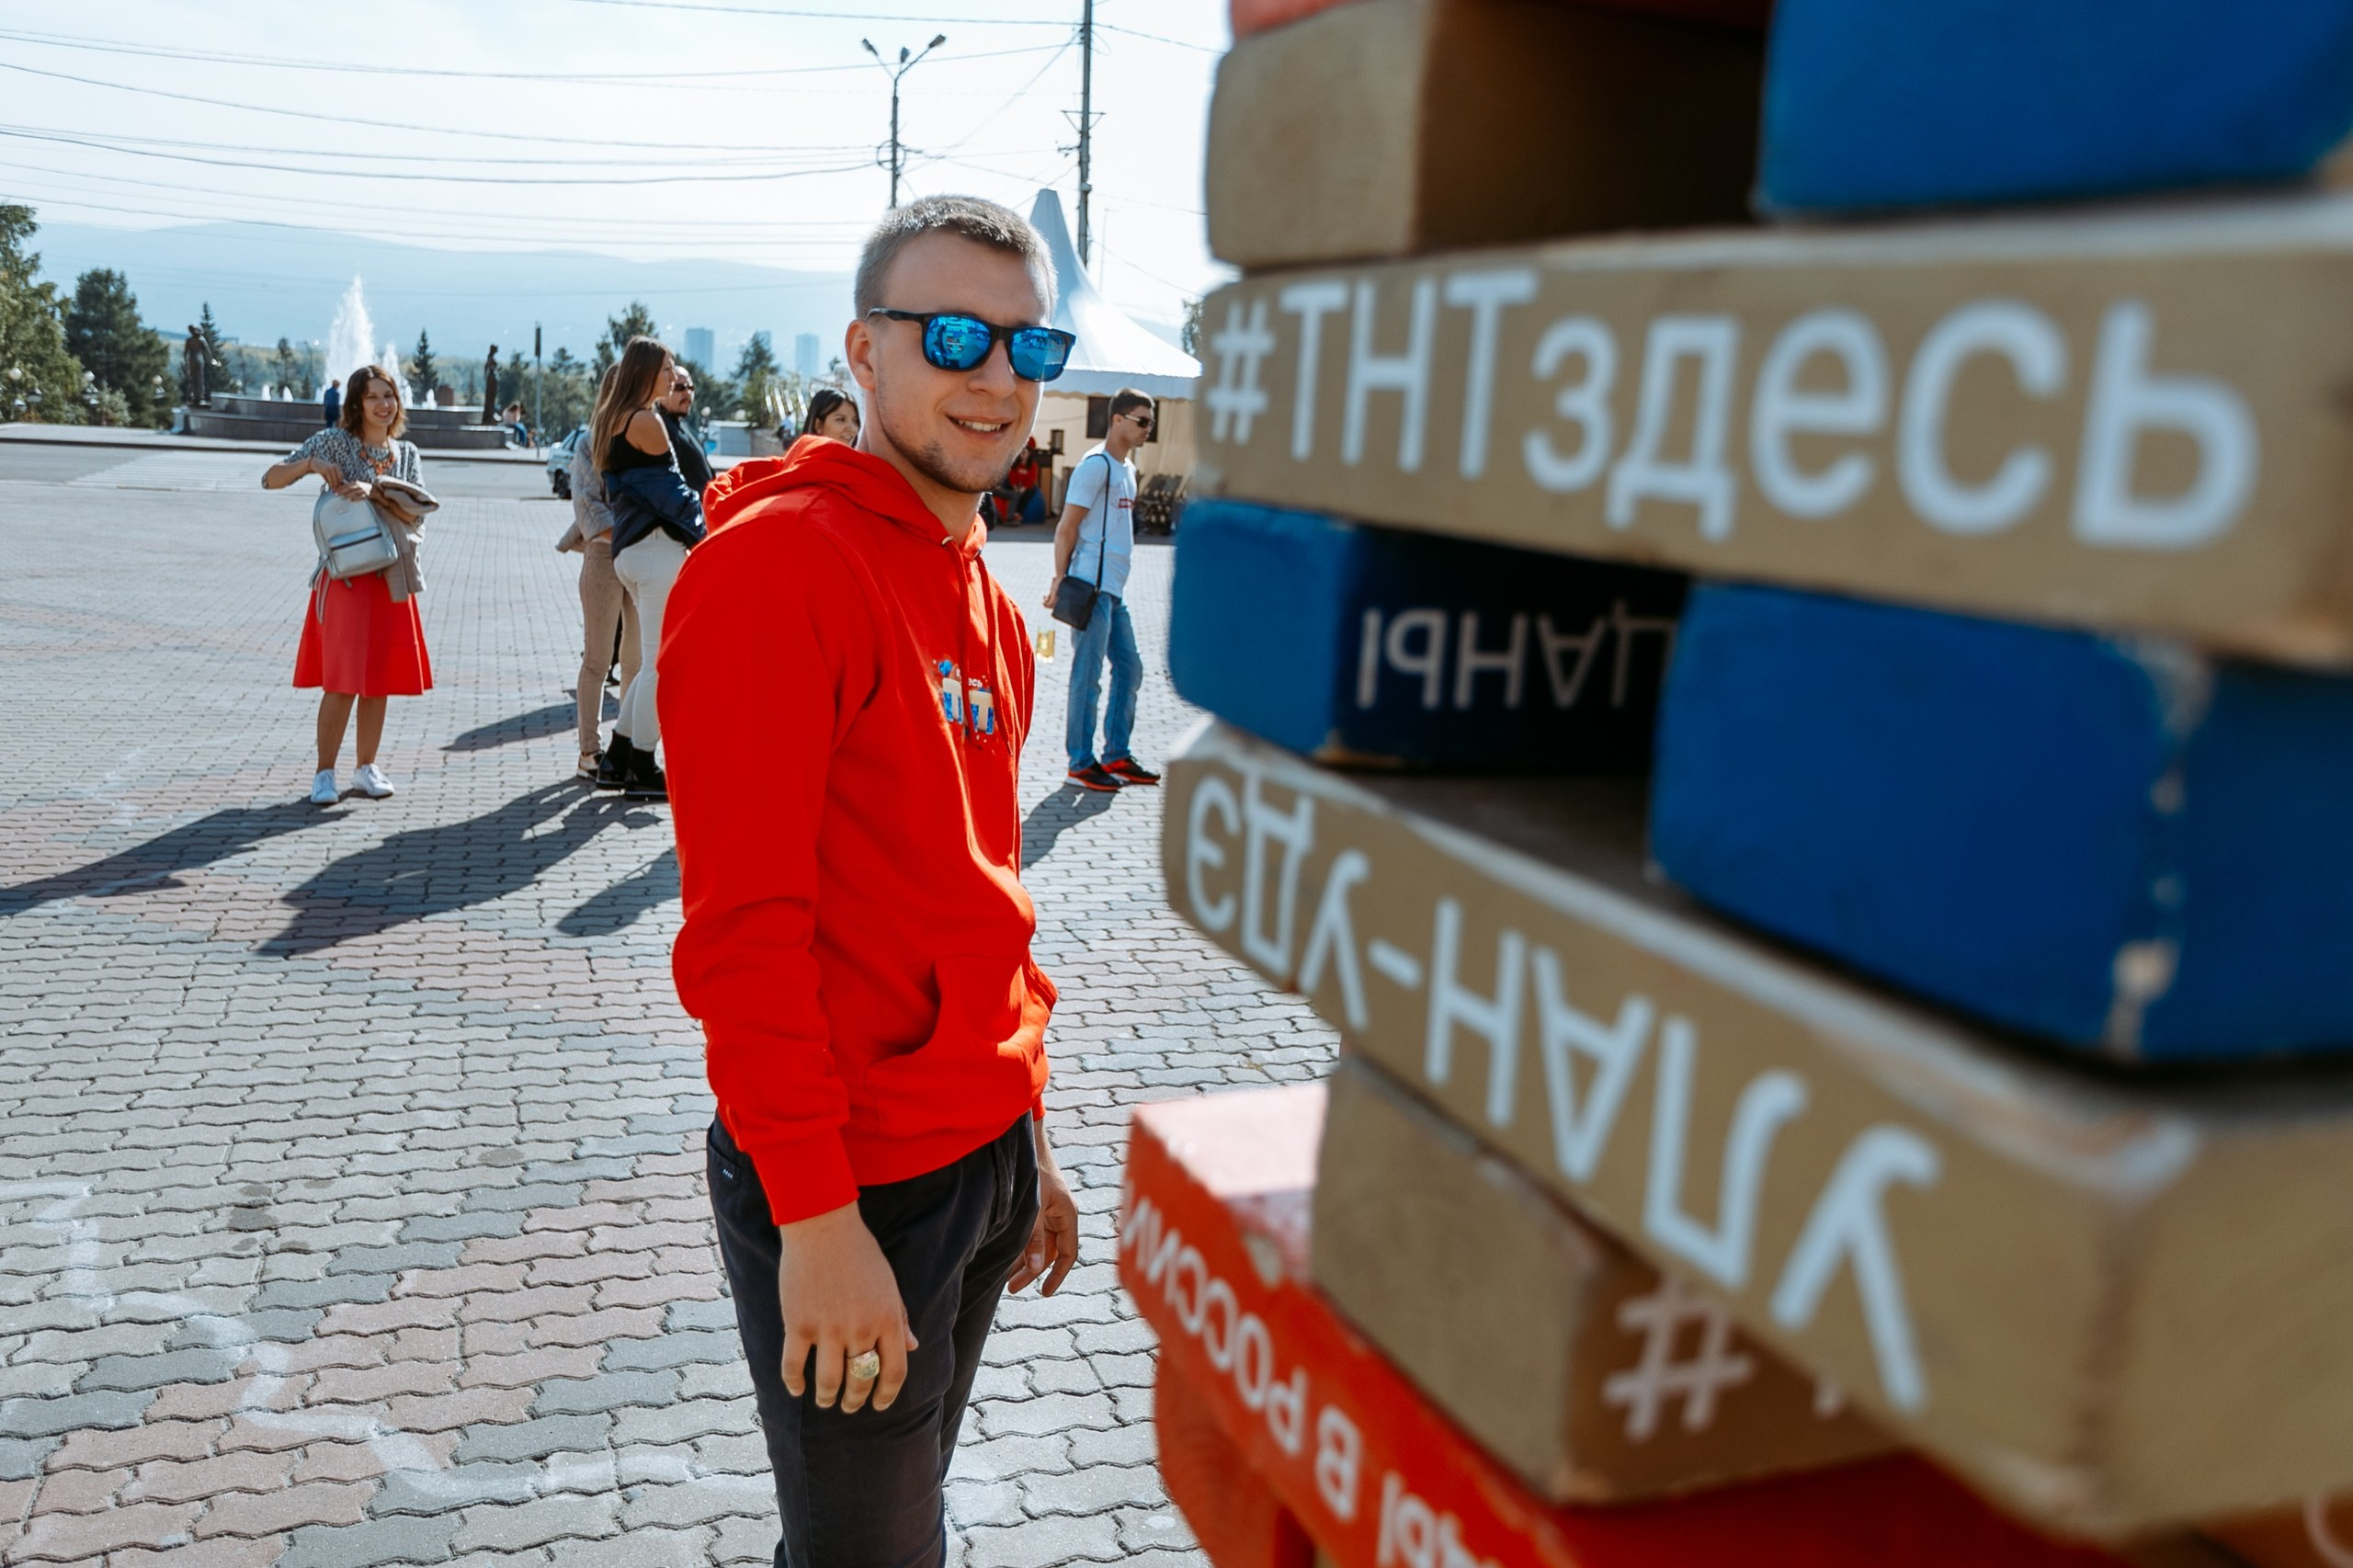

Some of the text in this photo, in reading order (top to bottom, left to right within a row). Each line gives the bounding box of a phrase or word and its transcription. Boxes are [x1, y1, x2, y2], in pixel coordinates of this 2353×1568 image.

[1204, 267, 2261, 550] #ТНТздесь
[1187, 766, 1943, 1414] УЛАН-УДЭ
[1120, 1180, 1309, 1457] РОССИИ
[1314, 1404, 1362, 1523] В
